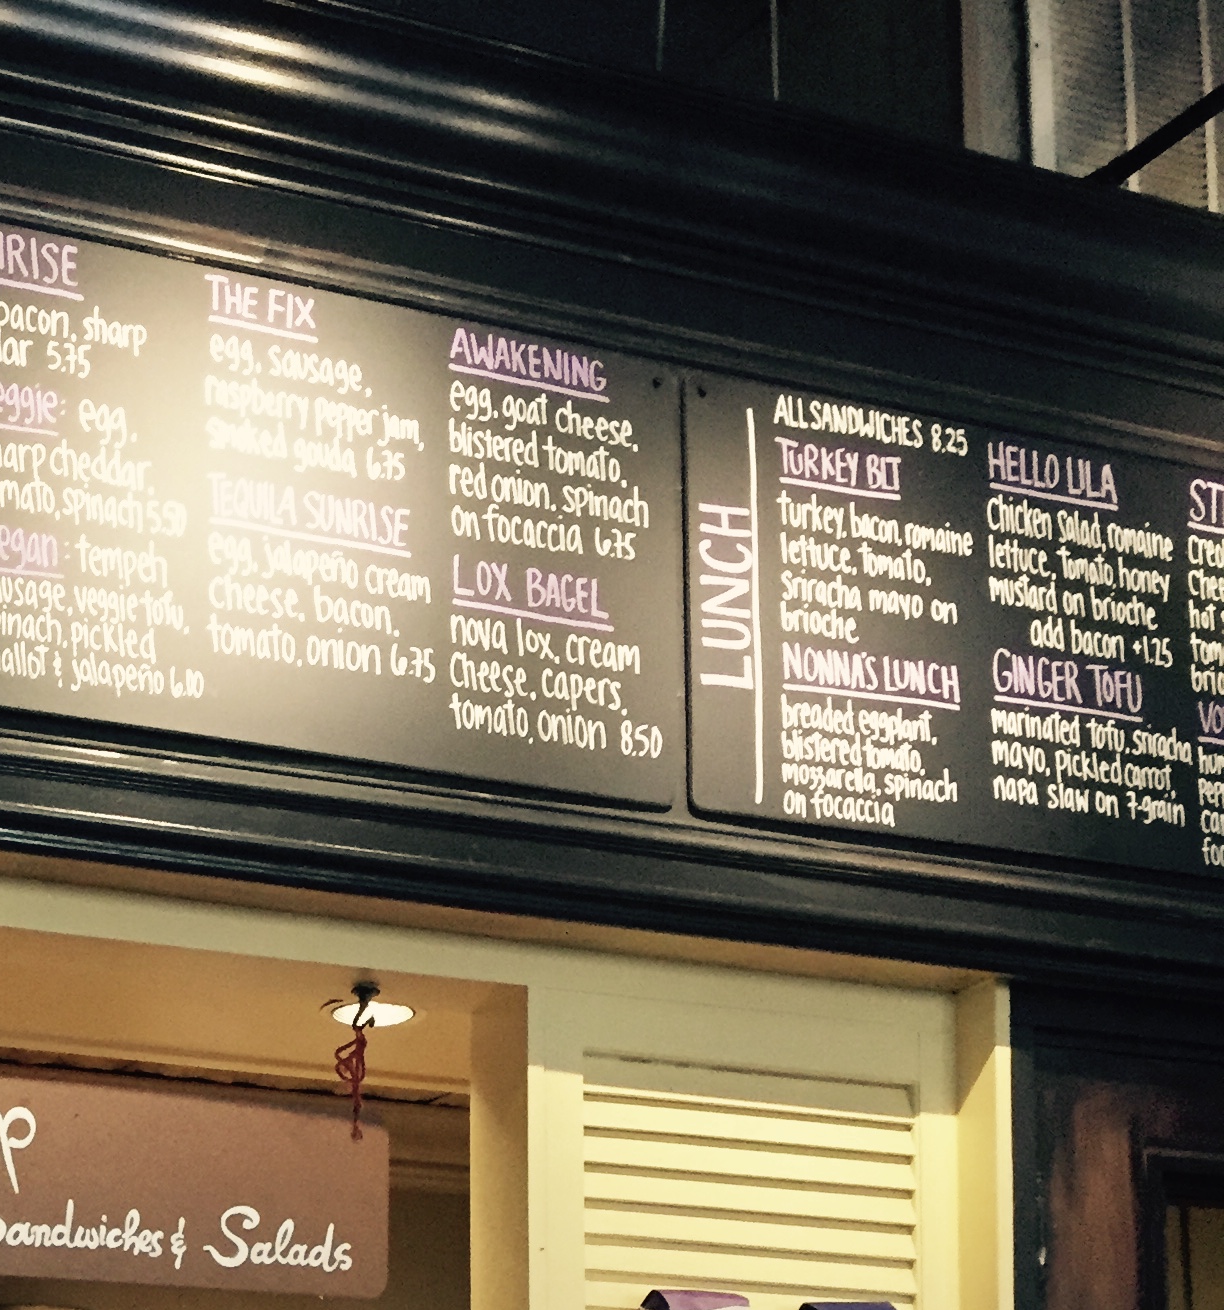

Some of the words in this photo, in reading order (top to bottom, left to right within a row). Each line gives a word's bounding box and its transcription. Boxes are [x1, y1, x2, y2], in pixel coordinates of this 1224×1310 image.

[204, 273, 259, 320] THE
[267, 288, 316, 329] FIX
[82, 305, 147, 356] sharp
[450, 328, 607, 391] AWAKENING
[314, 396, 378, 443] pepper
[502, 393, 548, 431] goat
[773, 393, 808, 429] ALL
[810, 400, 923, 449] SANDWICHES
[931, 423, 968, 457] 8.25
[293, 437, 357, 478] gouda
[449, 417, 538, 468] blistered
[774, 437, 859, 487] TURKEY
[449, 462, 487, 500] red
[562, 483, 649, 528] spinach
[987, 441, 1060, 489] HELLO
[1067, 456, 1117, 503] ULA
[62, 482, 143, 533] spinach
[207, 472, 297, 525] TEQUILA
[303, 491, 410, 547] SUNRISE
[451, 505, 480, 541] on
[482, 504, 583, 554] focaccia
[75, 534, 167, 588] tempeh
[904, 522, 974, 557] romaine
[1107, 522, 1174, 562] romaine
[74, 584, 138, 624] veggie
[365, 564, 431, 604] cream
[453, 554, 512, 601] LOX
[526, 567, 609, 619] BAGEL
[698, 502, 754, 690] LUNCH
[988, 575, 1058, 614] mustard
[1062, 590, 1085, 617] on
[1090, 586, 1158, 630] brioche
[1118, 557, 1170, 602] honey
[780, 604, 859, 644] brioche
[869, 588, 923, 620] mayo
[930, 599, 957, 625] on
[1188, 599, 1217, 631] hot
[71, 617, 157, 664] pickled
[307, 627, 381, 676] onion
[450, 614, 508, 655] nova
[565, 633, 641, 674] cream
[1030, 616, 1065, 652] add
[1070, 619, 1125, 662] bacon
[783, 642, 878, 690] NONNA'S
[883, 656, 960, 704] LUNCH
[992, 647, 1083, 704] GINGER
[1085, 664, 1142, 713] TOFU
[537, 708, 606, 750] onion
[620, 720, 663, 758] 8.50
[781, 693, 854, 735] breaded
[991, 706, 1080, 747] marinated
[781, 730, 862, 766] blistered
[1055, 748, 1122, 785] pickled
[783, 790, 806, 818] on
[810, 789, 895, 827] focaccia
[884, 768, 957, 802] spinach
[993, 775, 1039, 805] napa
[1047, 783, 1089, 814] slaw
[1095, 790, 1119, 818] on
[203, 1205, 353, 1273] Salads
